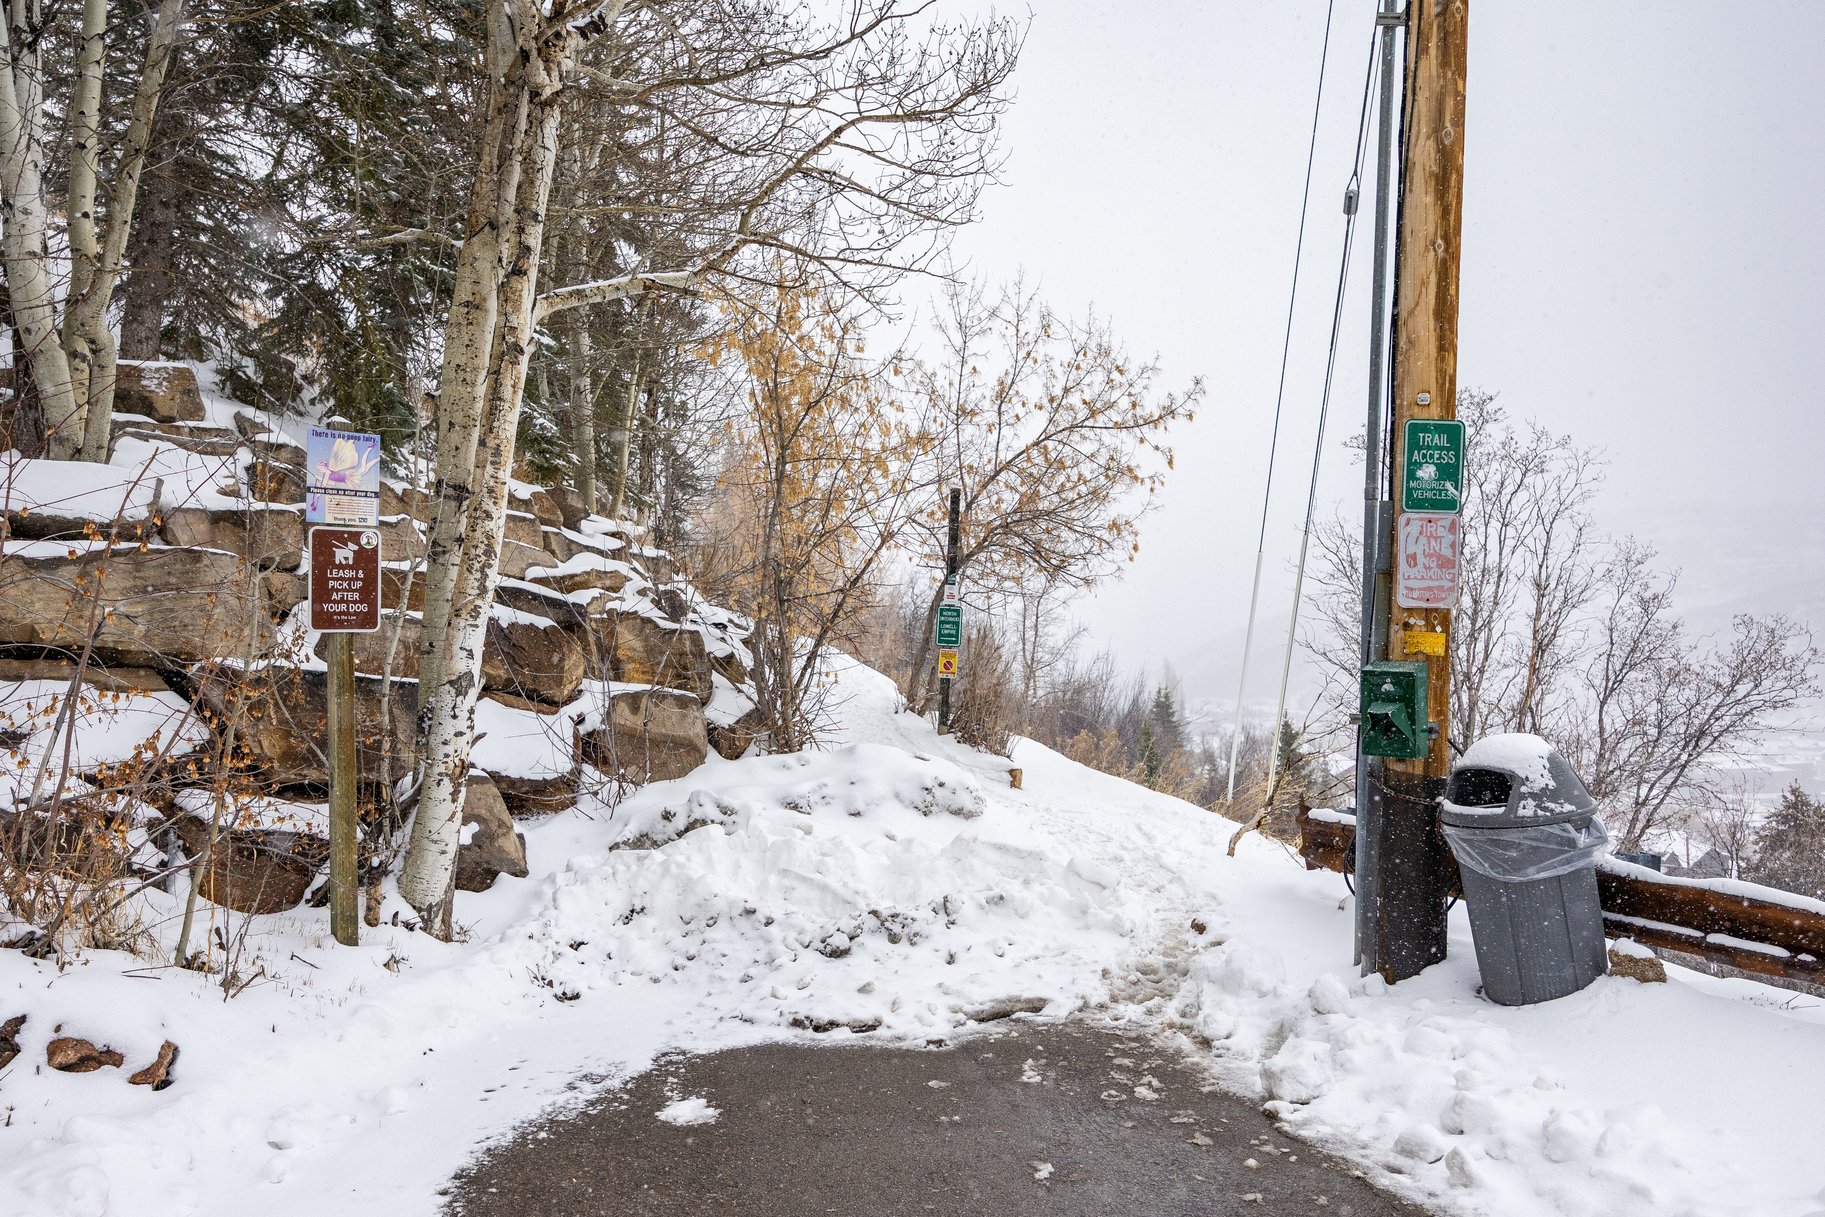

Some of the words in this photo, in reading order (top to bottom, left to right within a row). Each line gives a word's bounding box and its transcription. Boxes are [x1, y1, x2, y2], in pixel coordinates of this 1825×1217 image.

[312, 429, 328, 438] There
[1418, 433, 1450, 446] TRAIL
[1412, 450, 1455, 463] ACCESS
[1409, 480, 1455, 489] MOTORIZED
[1412, 490, 1451, 499] VEHICLES
[328, 569, 356, 578] LEASH
[358, 570, 364, 578] &
[1403, 569, 1454, 581] PARKING
[328, 580, 349, 589] PICK
[350, 581, 362, 589] UP
[332, 592, 360, 600] AFTER
[322, 603, 347, 612] YOUR
[349, 604, 368, 612] DOG
